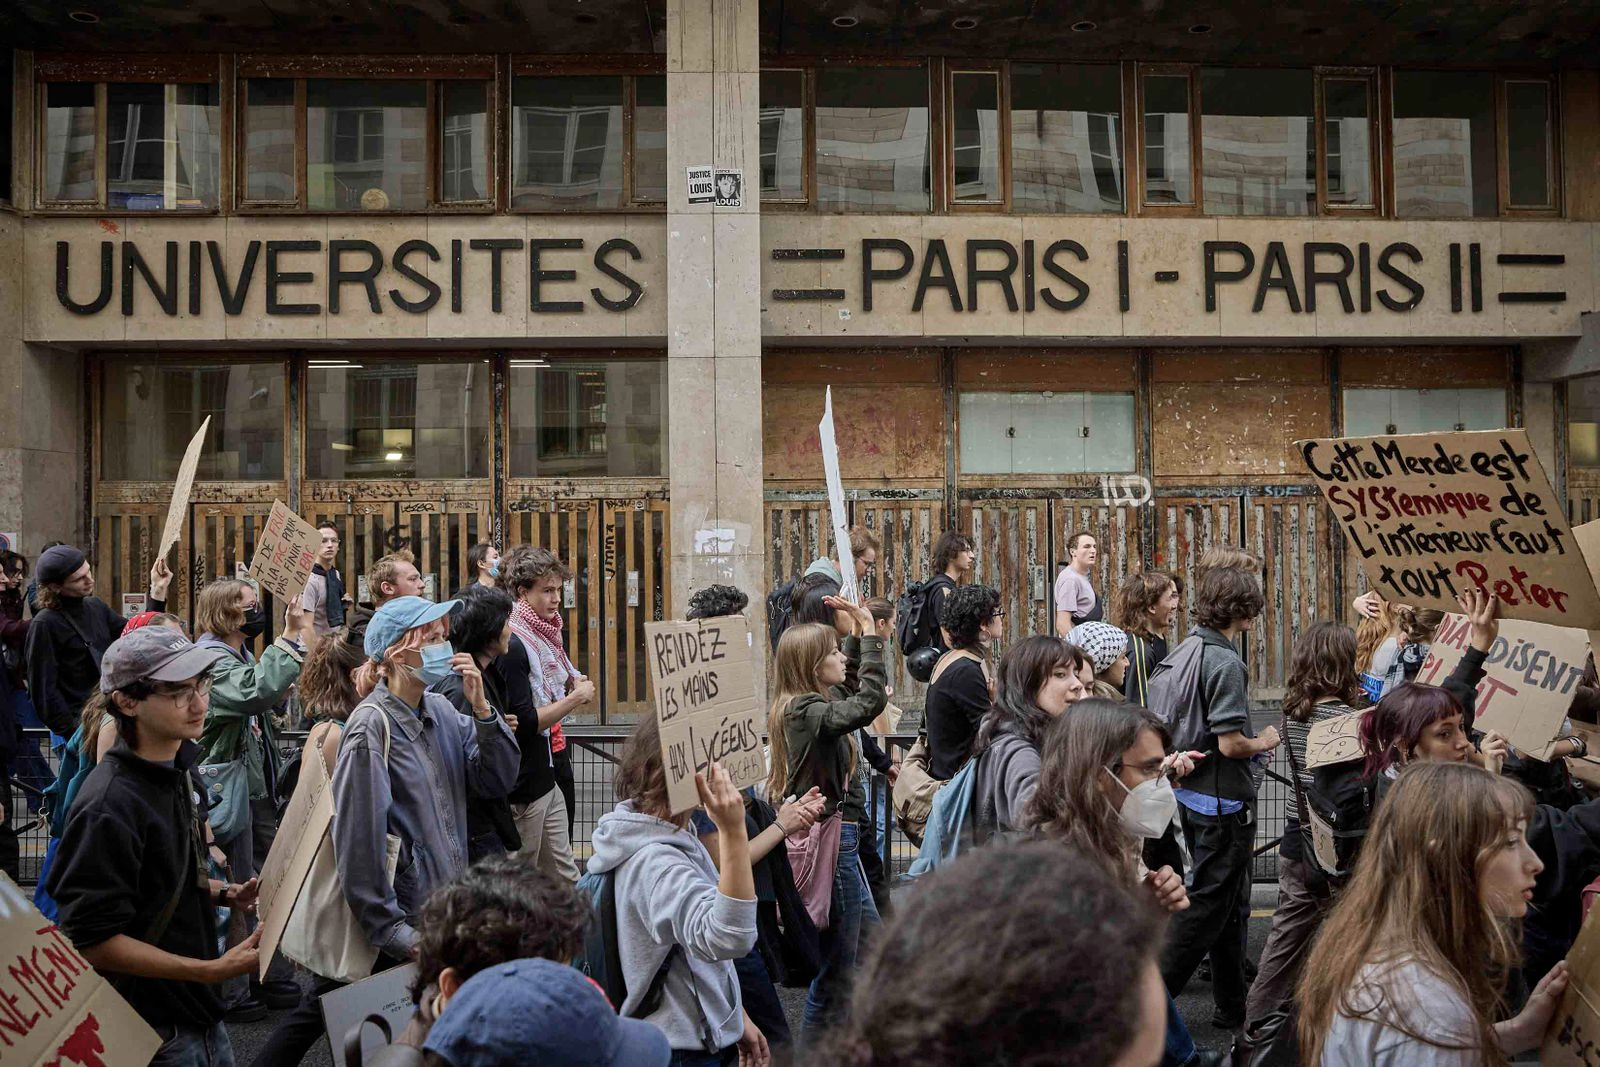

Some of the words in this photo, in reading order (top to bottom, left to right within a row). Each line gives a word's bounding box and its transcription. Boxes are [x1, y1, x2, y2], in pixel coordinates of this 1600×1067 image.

[689, 170, 711, 179] JUSTICE
[690, 183, 713, 194] LOUIS
[716, 198, 741, 206] LOUIS
[56, 239, 645, 318] UNIVERSITES
[862, 239, 1090, 313] PARIS
[1117, 240, 1130, 313] I
[1203, 241, 1425, 314] PARIS
[1449, 242, 1483, 314] II
[1302, 441, 1378, 483] Cette
[1372, 440, 1469, 478] Merde
[1471, 439, 1530, 483] est
[1500, 483, 1547, 517] de
[261, 538, 275, 560] DE
[269, 506, 286, 538] FRIC
[282, 517, 297, 542] POUR
[1489, 517, 1565, 555] faut
[272, 542, 288, 568] FAC
[299, 544, 316, 572] BAC
[267, 567, 280, 581] LA
[275, 576, 289, 596] PAS
[294, 570, 307, 586] LA
[1380, 561, 1459, 599] tout
[1456, 560, 1569, 613] Peter
[654, 627, 728, 679] RENDEZ
[659, 686, 680, 722] LES
[682, 670, 719, 708] MAINS
[668, 741, 690, 785] AUX
[689, 717, 758, 782] LYCÉENS
